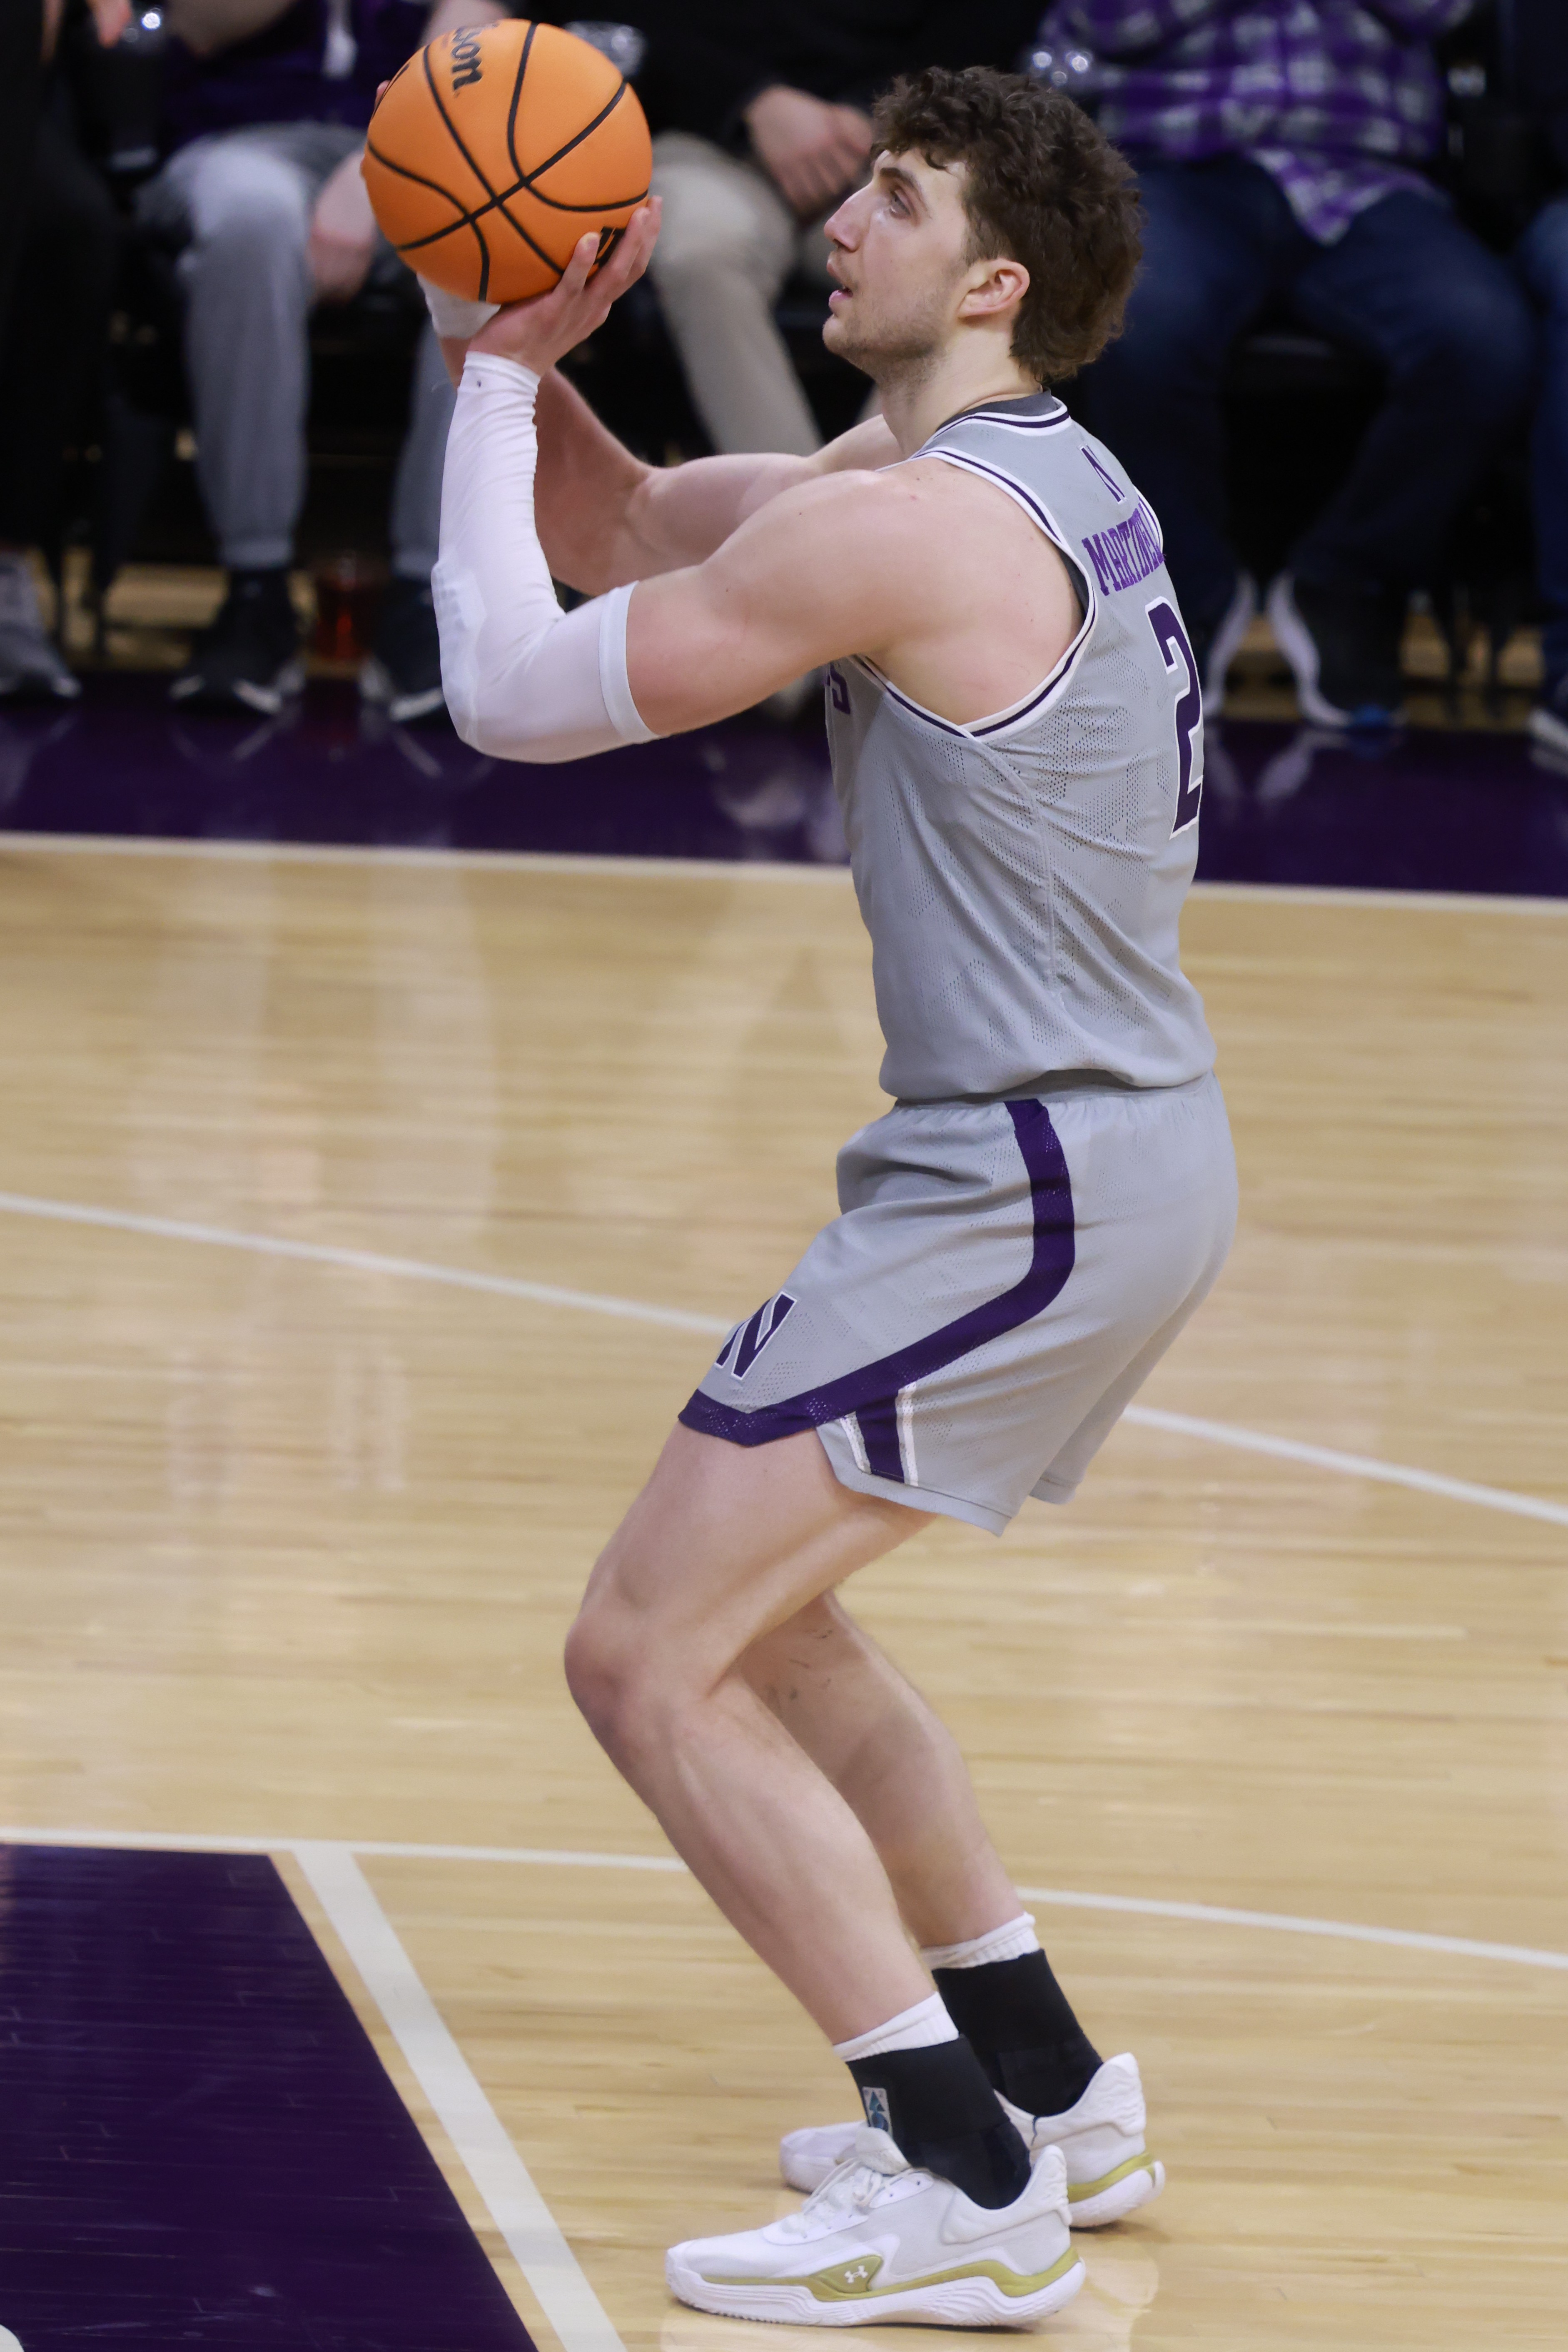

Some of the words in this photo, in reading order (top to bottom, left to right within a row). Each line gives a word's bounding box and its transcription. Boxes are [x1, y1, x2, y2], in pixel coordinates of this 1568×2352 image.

[451, 25, 484, 91] son
[1144, 596, 1204, 841] 2
[714, 1291, 798, 1380] N
